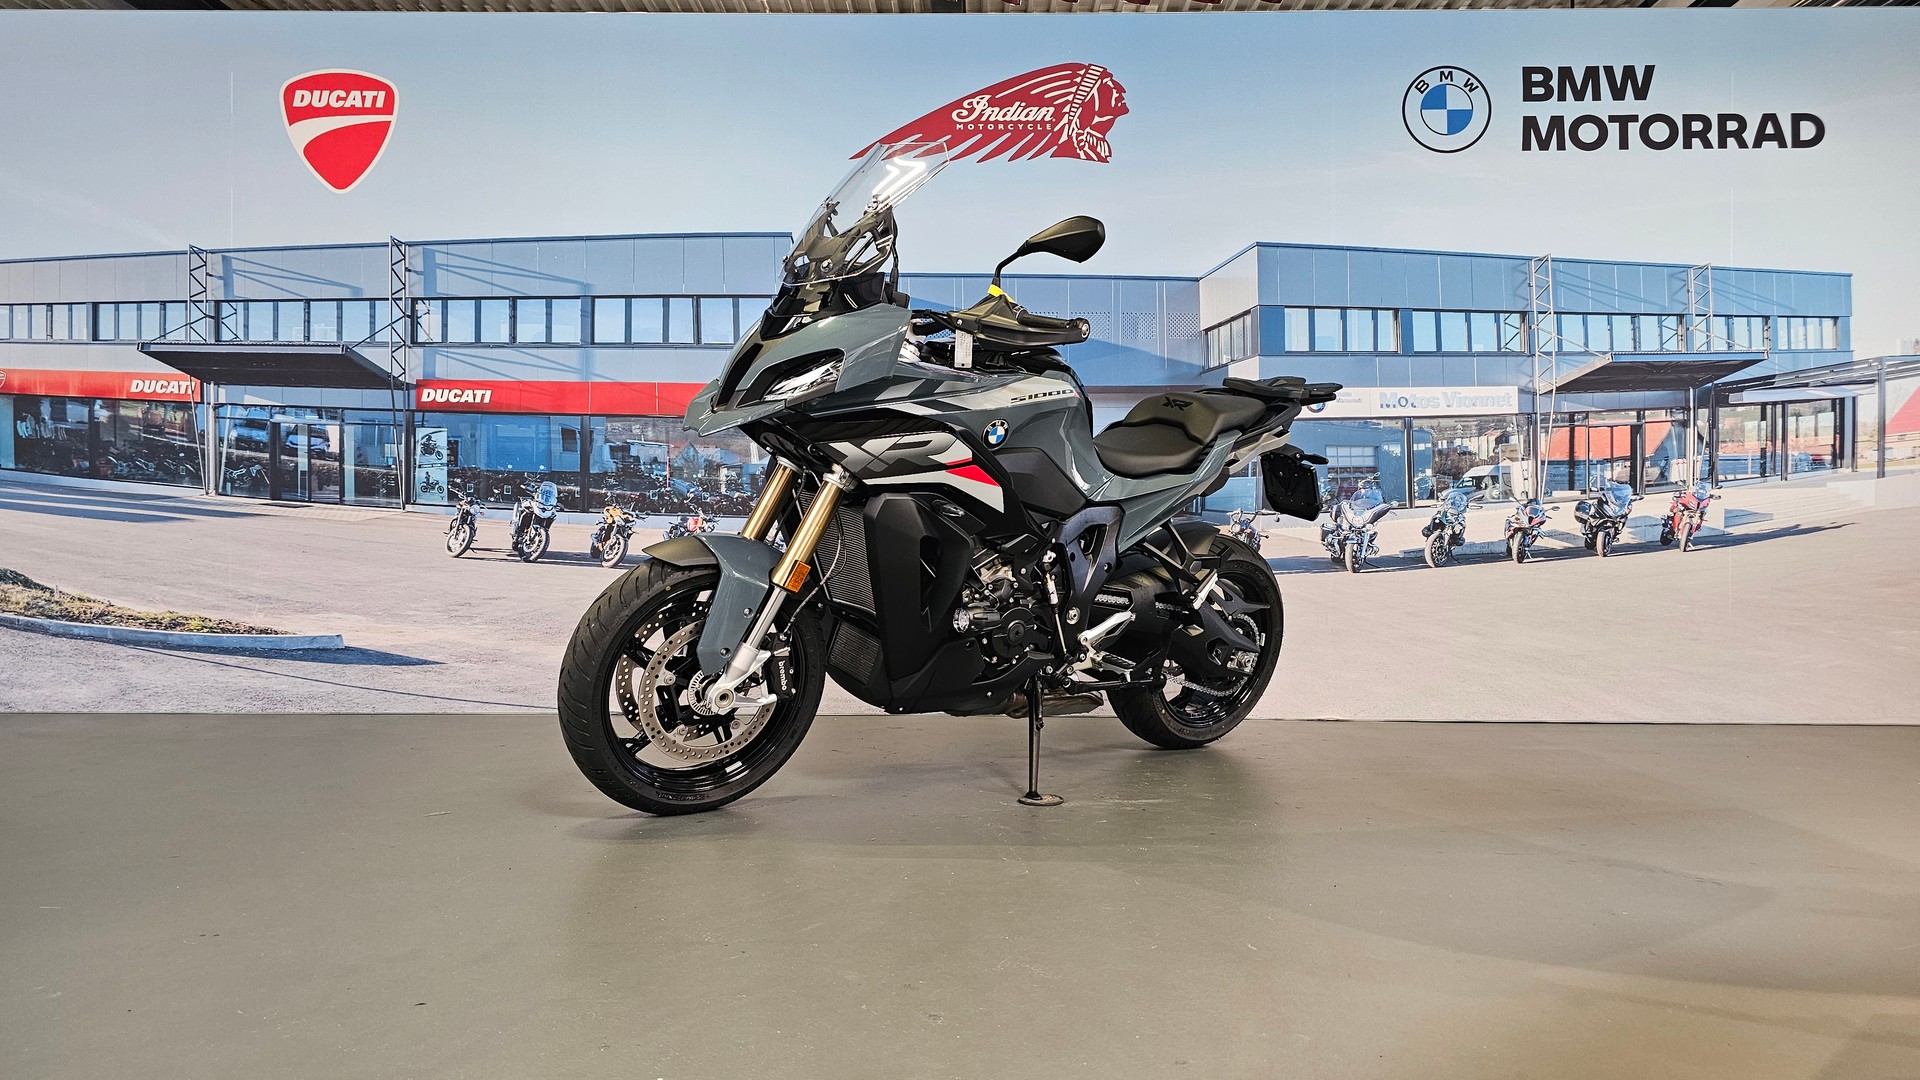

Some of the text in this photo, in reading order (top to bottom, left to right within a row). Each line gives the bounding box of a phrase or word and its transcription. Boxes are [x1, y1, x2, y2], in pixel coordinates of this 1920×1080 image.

[1414, 70, 1480, 95] BMW
[1521, 64, 1656, 103] BMW
[292, 89, 386, 108] DUCATI
[951, 94, 1056, 123] Indian
[1521, 113, 1826, 151] MOTORRAD
[129, 379, 196, 395] DUCATI
[420, 388, 492, 404] DUCATI
[1161, 396, 1194, 411] XR
[1379, 391, 1440, 409] Motos
[1441, 391, 1513, 408] Vionnet
[778, 660, 788, 691] brembo
